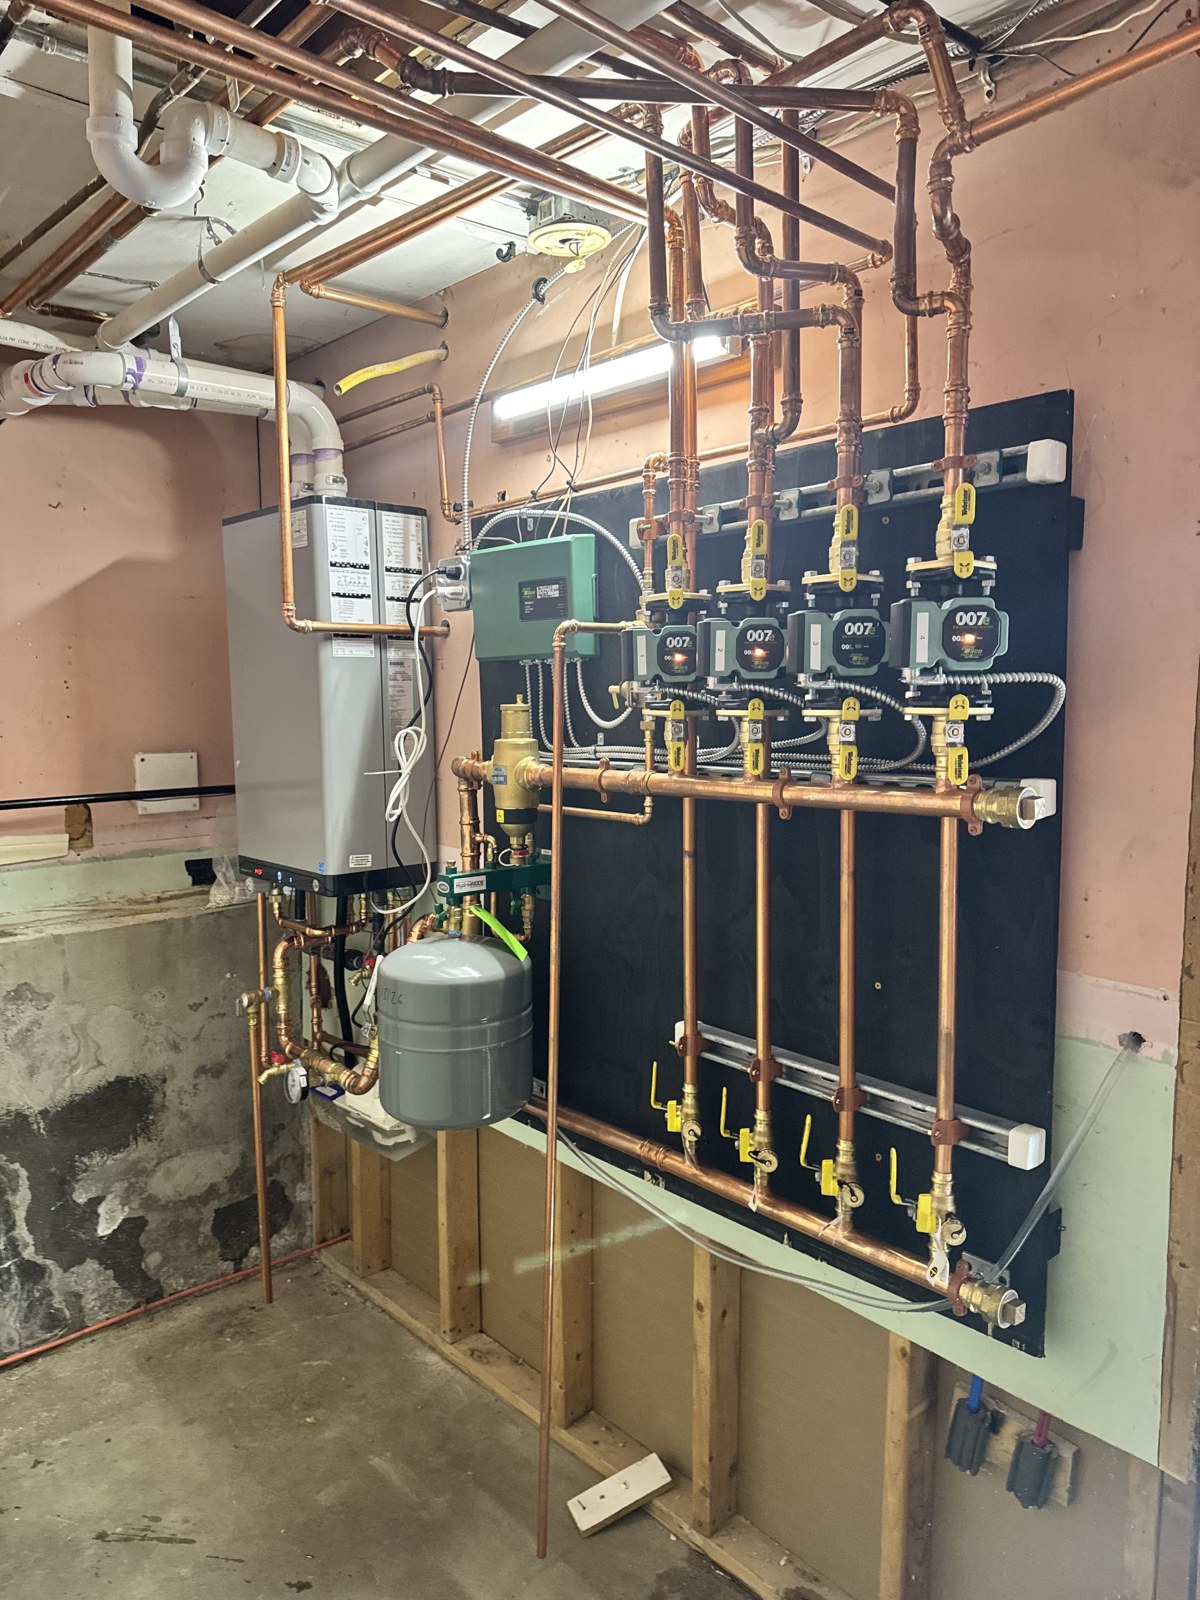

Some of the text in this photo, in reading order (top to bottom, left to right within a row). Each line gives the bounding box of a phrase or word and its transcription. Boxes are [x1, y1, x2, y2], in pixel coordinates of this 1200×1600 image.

[955, 612, 990, 626] 007e
[844, 622, 875, 635] 007e
[666, 636, 692, 648] 007e
[746, 630, 775, 642] 007e
